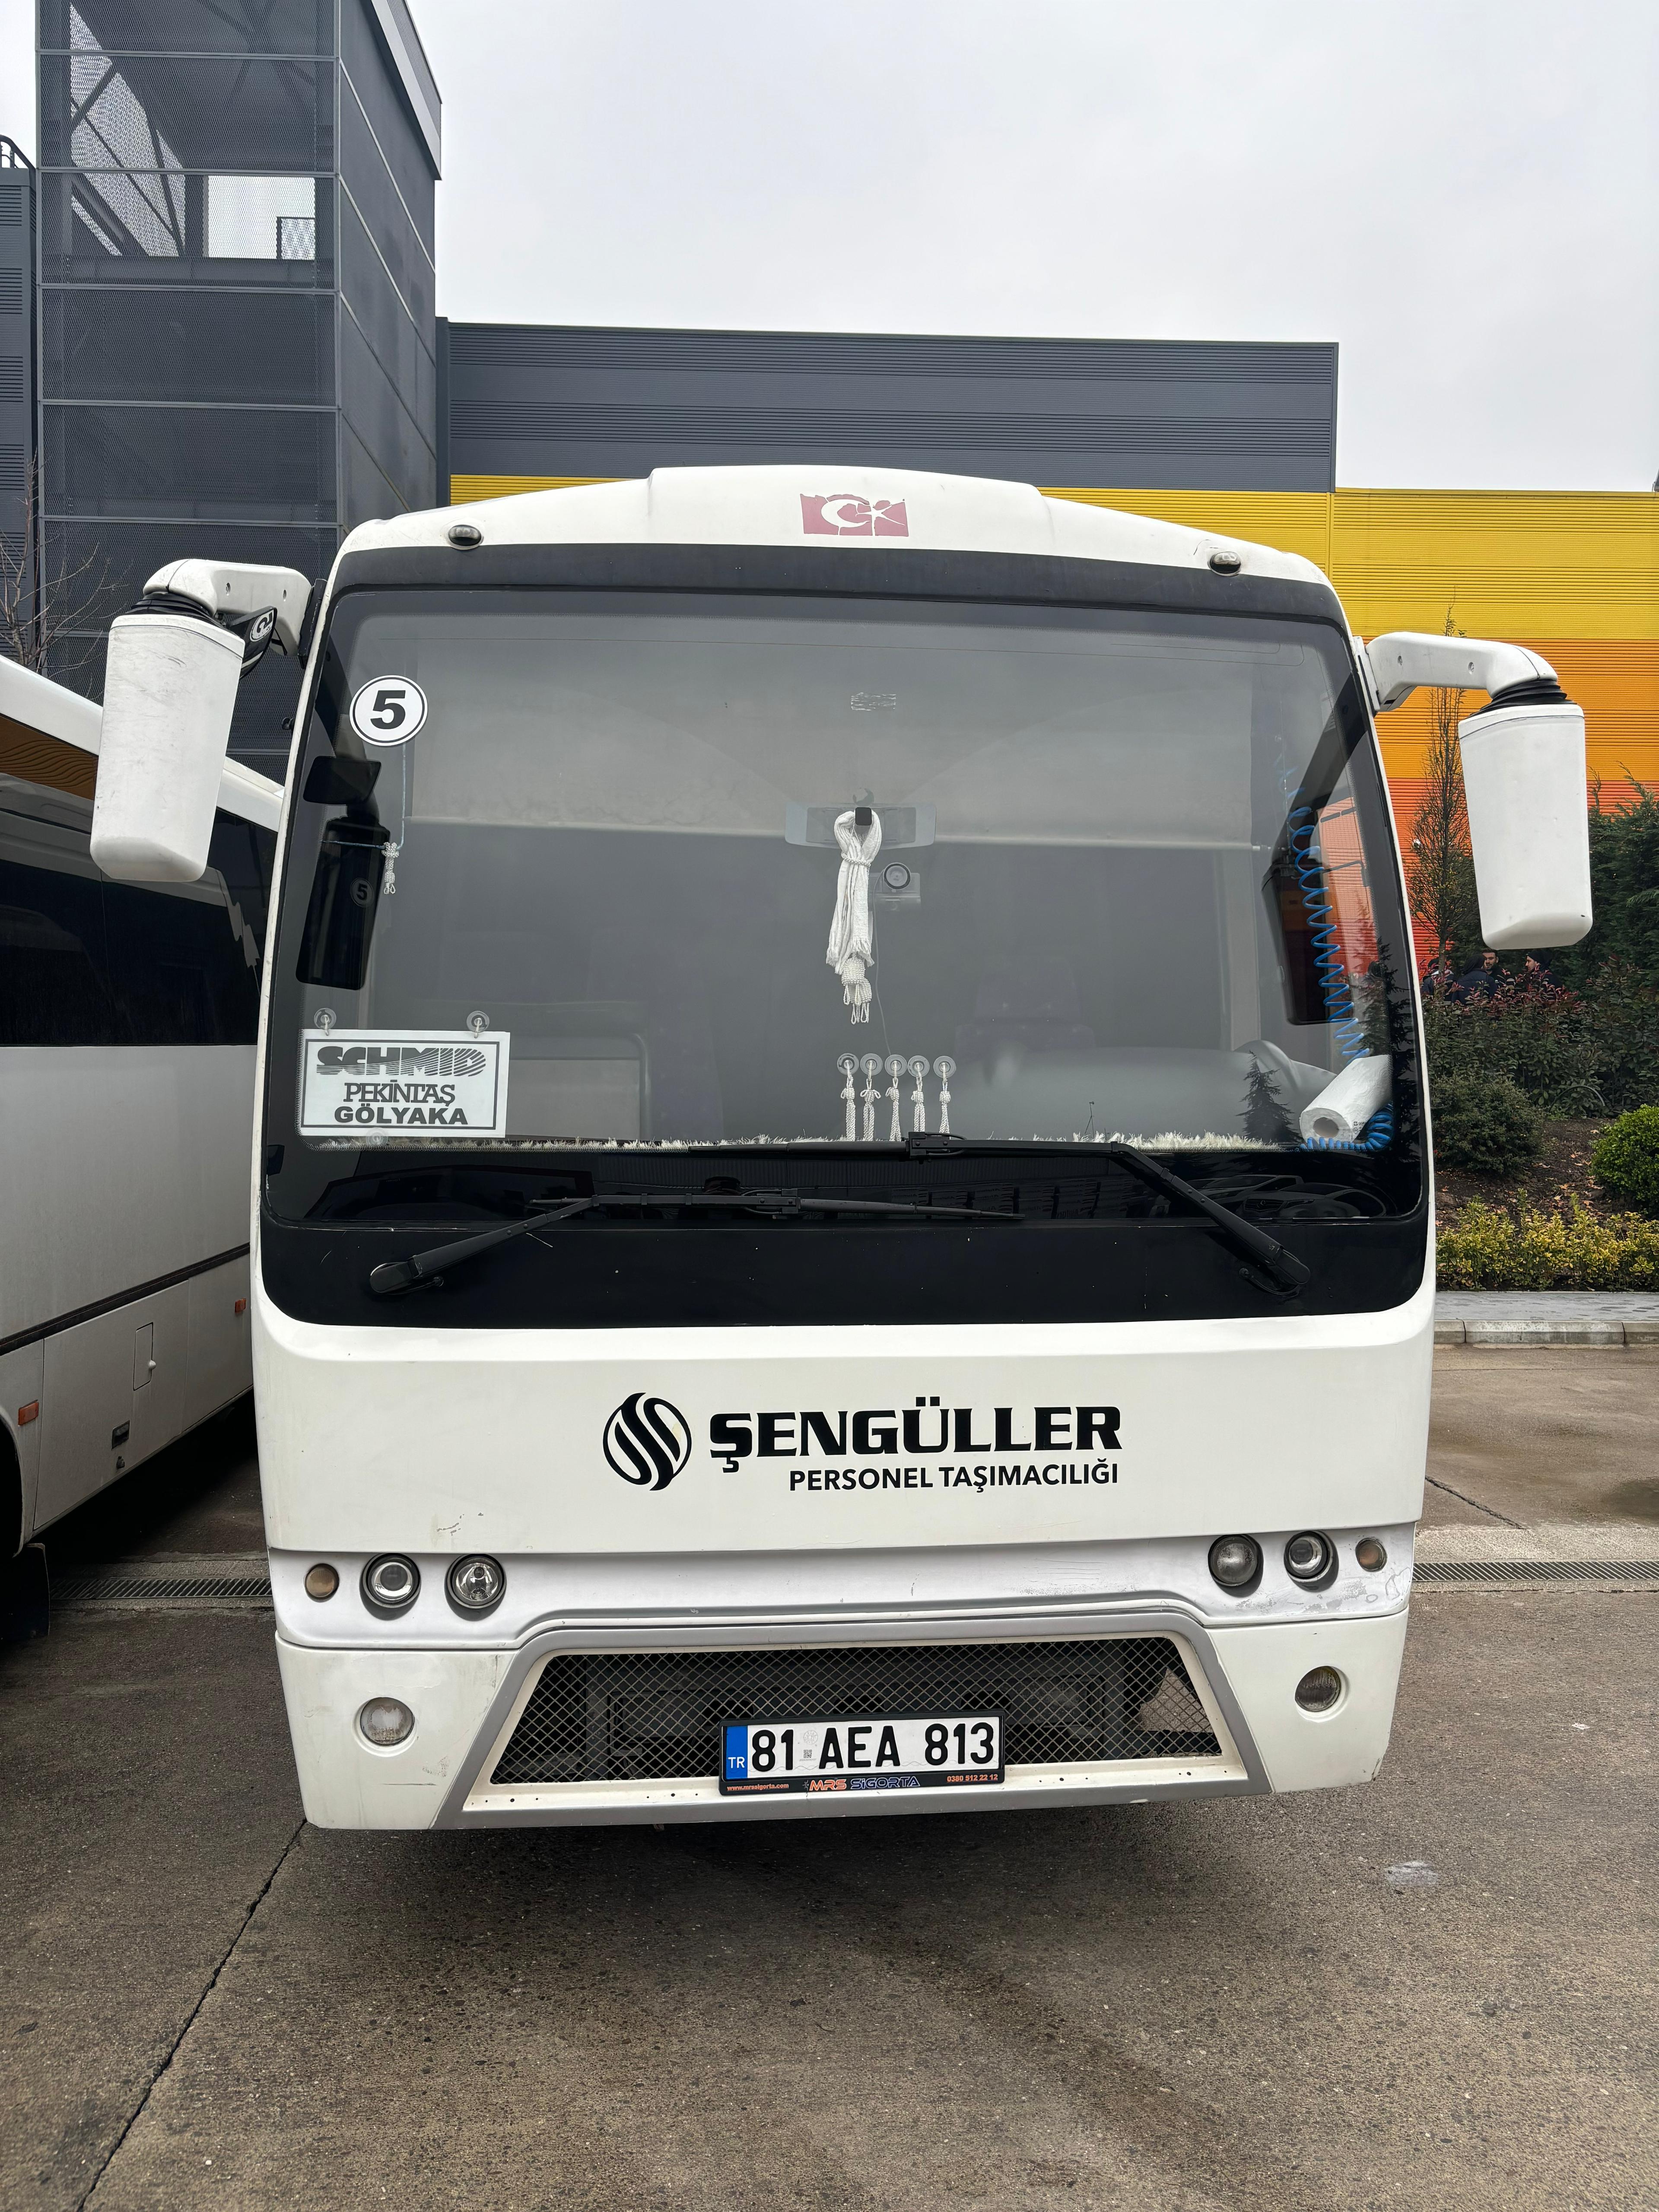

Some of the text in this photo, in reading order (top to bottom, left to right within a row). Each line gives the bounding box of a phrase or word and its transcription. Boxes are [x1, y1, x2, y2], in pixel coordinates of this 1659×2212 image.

[370, 690, 406, 730] 5
[356, 883, 368, 900] 5
[316, 1046, 486, 1077] SCHMID
[343, 1080, 455, 1107] PEKİNTAŞ
[334, 1103, 468, 1125] GÖLYAKA
[710, 1397, 1122, 1473] ŞENGÜLLER
[790, 1458, 1117, 1493] PERSONEL TAŞIMACILIĞI
[752, 1723, 994, 1772] 81 AEA 813
[728, 1757, 745, 1768] TR
[809, 1780, 846, 1791] MRS
